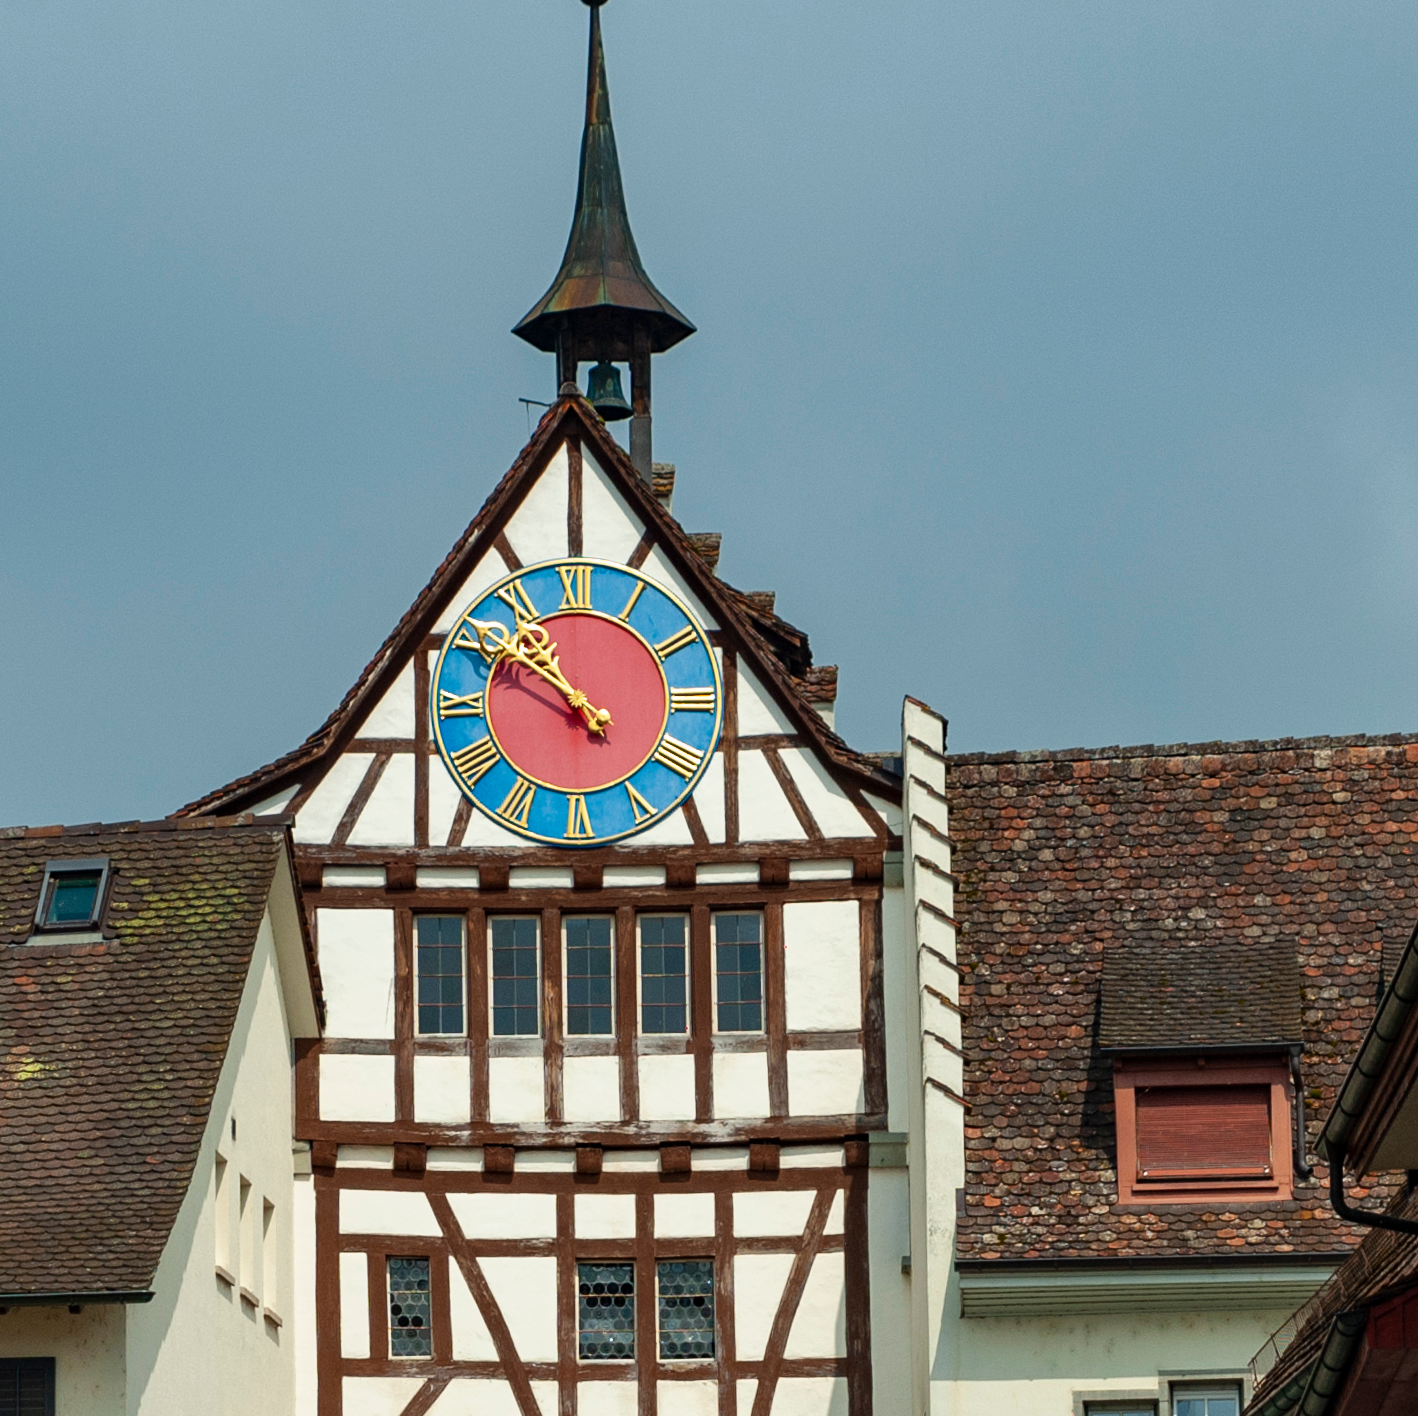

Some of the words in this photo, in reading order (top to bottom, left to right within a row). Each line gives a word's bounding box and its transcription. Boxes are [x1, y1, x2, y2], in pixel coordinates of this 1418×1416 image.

[555, 565, 593, 610] XII
[618, 580, 647, 622] I
[653, 624, 699, 661] II
[439, 688, 484, 720] IX
[670, 685, 715, 715] III
